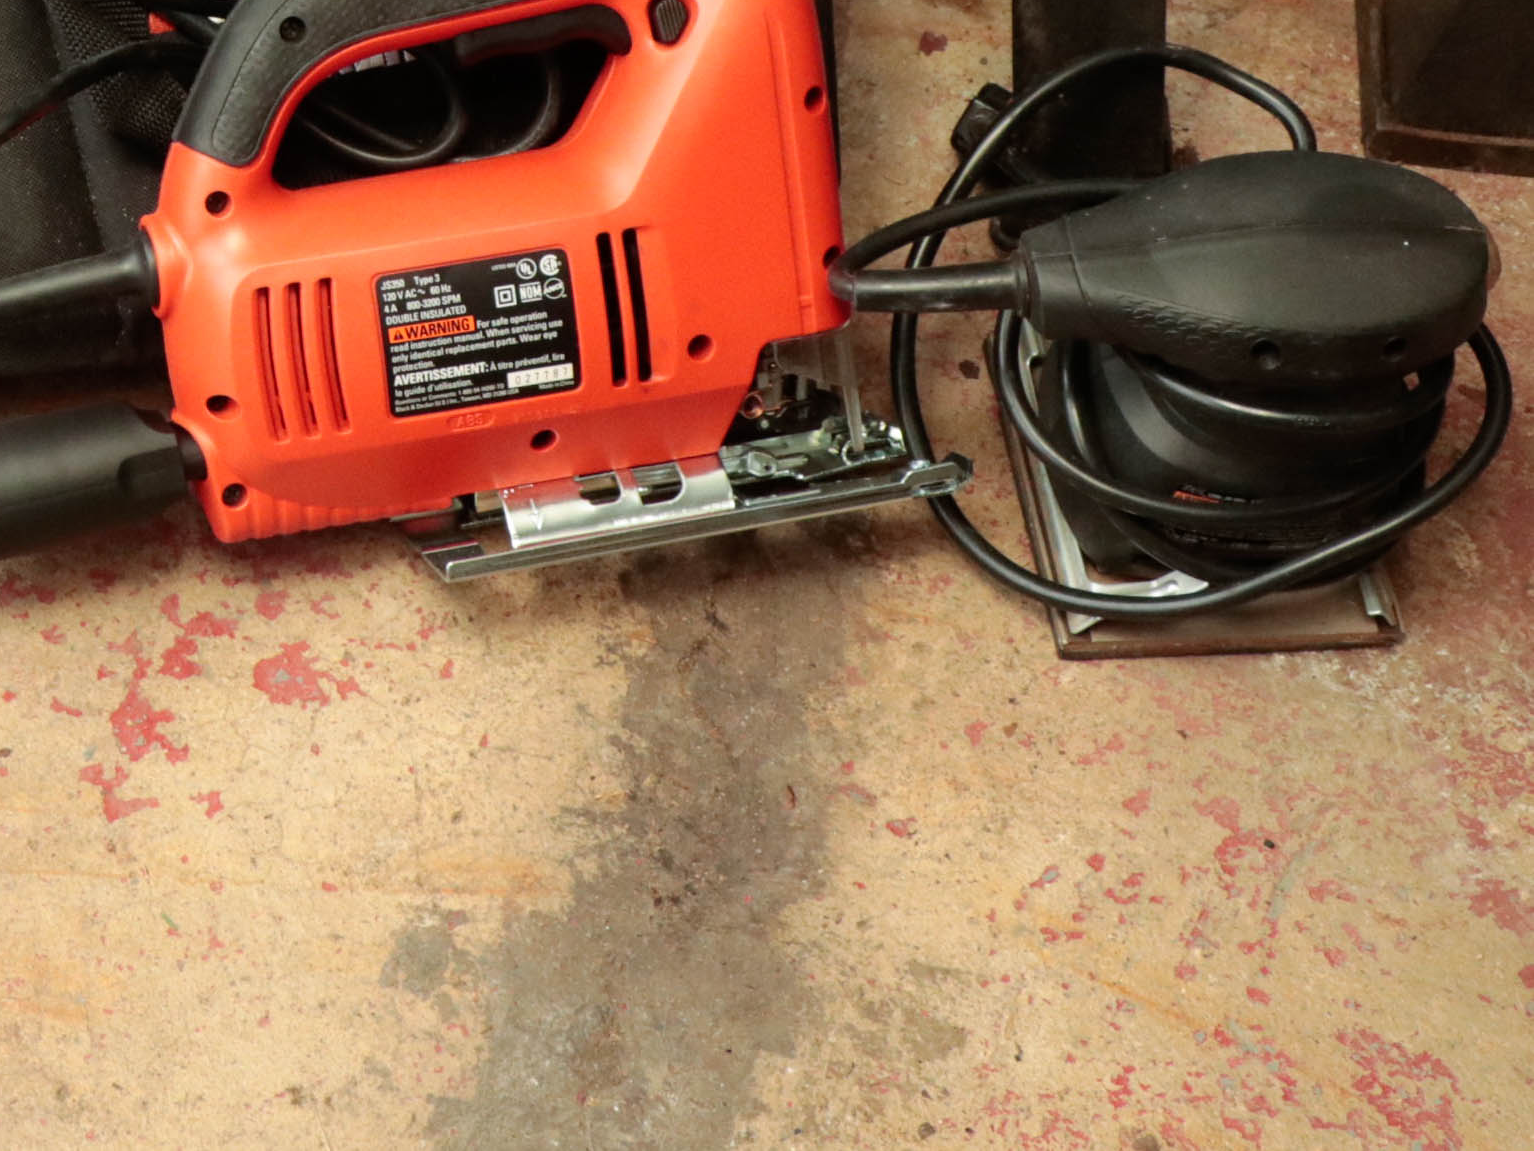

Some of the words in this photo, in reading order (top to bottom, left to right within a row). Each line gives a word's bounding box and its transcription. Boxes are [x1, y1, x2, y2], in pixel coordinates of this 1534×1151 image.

[413, 275, 434, 287] Type
[434, 273, 440, 282] 3
[383, 292, 397, 302] 120
[397, 290, 403, 300] V
[405, 288, 417, 299] AC
[440, 283, 451, 293] Hz
[519, 284, 542, 300] NOM
[391, 303, 398, 312] A
[442, 293, 462, 305] SPM
[385, 312, 419, 325] DOUBLE
[420, 304, 467, 320] INSULATED
[405, 318, 470, 339] WARNING
[477, 319, 490, 329] For
[491, 316, 509, 327] safe
[510, 311, 548, 324] operation
[390, 343, 409, 353] read
[410, 337, 453, 350] instruction
[453, 330, 485, 343] manual.
[485, 328, 510, 338] When
[511, 322, 547, 334] servicing
[548, 319, 563, 328] use
[391, 354, 408, 364] only
[410, 347, 444, 361] identical
[445, 339, 494, 356] replacement
[496, 337, 519, 348] parts.
[519, 333, 541, 343] Wear
[543, 331, 558, 340] eye
[393, 360, 435, 375] protection.
[394, 361, 489, 387] AVERTISSEMENT:
[404, 386, 426, 398] guide
